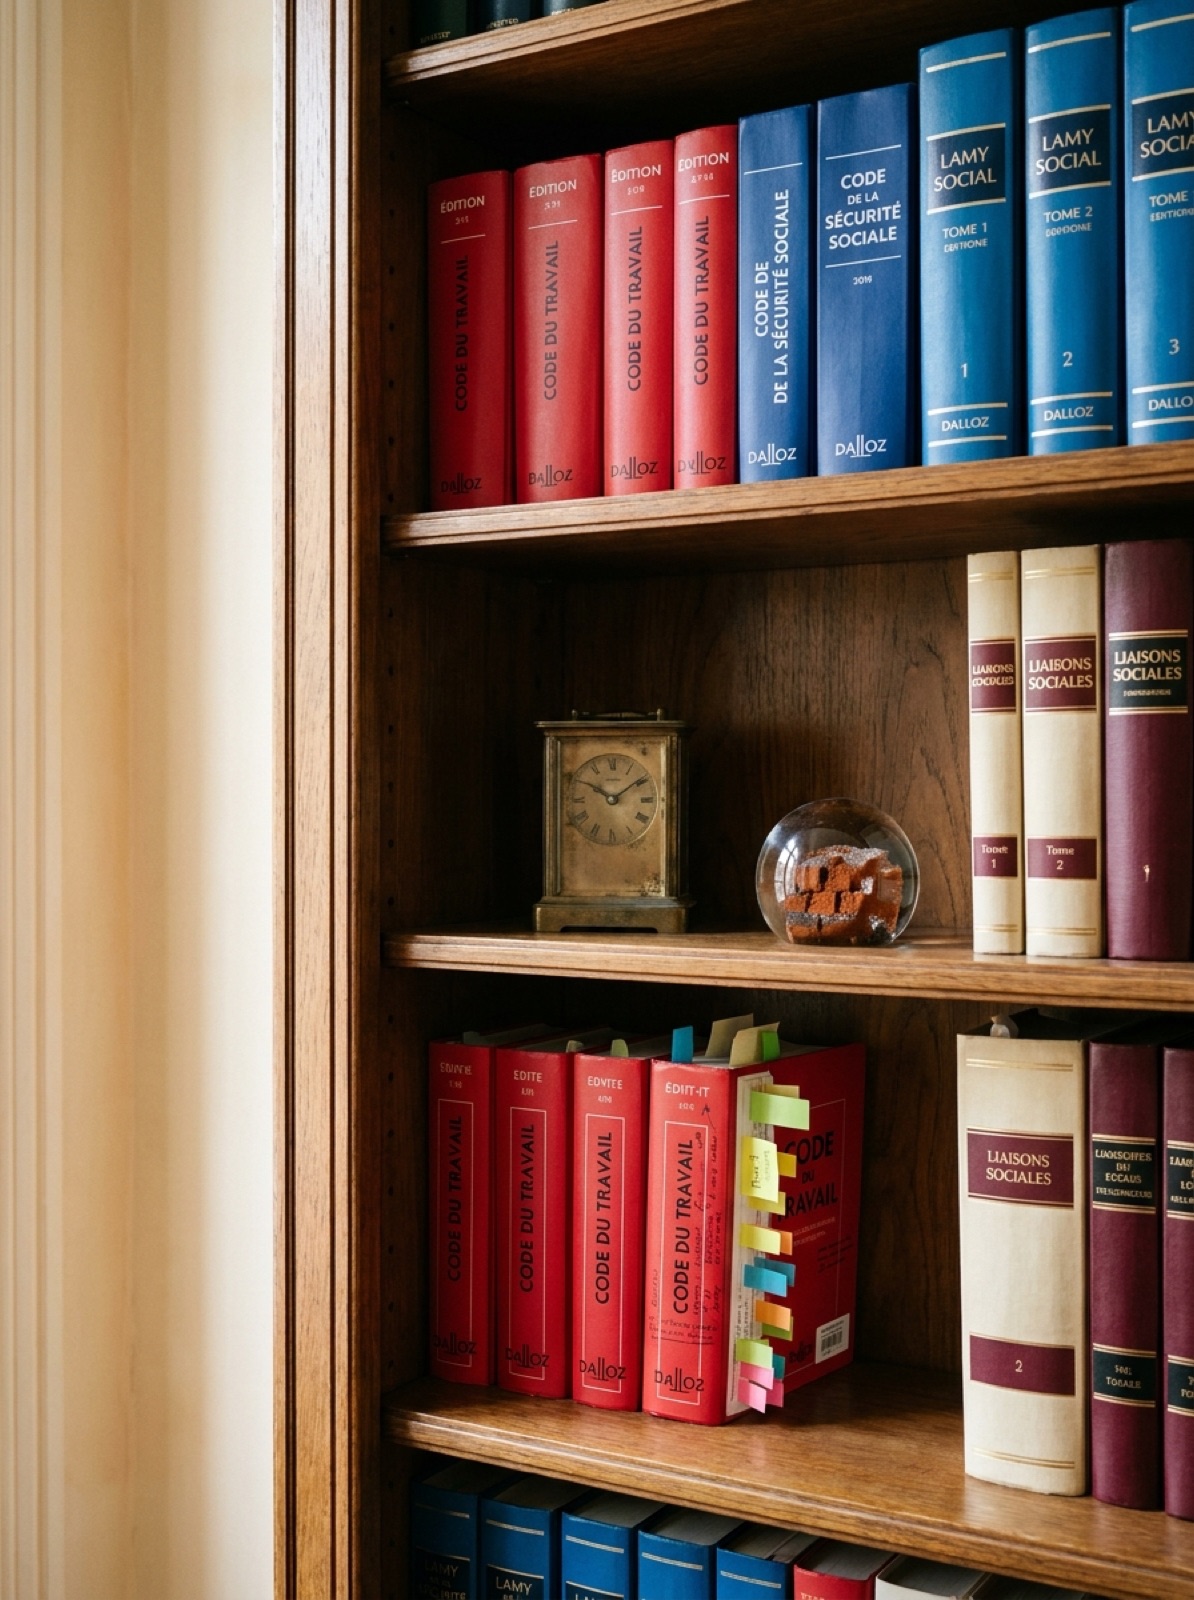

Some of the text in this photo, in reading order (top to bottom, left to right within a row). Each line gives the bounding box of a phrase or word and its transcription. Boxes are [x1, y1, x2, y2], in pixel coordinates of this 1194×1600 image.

[1043, 128, 1094, 152] LAMY
[941, 146, 989, 169] LAMY
[1035, 150, 1102, 176] SOCIAL
[840, 168, 886, 189] CODE
[933, 168, 997, 192] SOCIAL
[847, 191, 879, 205] DE LA
[1149, 190, 1189, 208] TOME
[825, 200, 901, 230] SÉCURITÉ
[1043, 206, 1094, 224] TOME 2
[828, 226, 898, 250] SOCIALE
[942, 222, 987, 239] TOME 1
[694, 215, 709, 386] CODE DU TRAVAIL
[755, 261, 769, 337] CODE DE
[772, 189, 789, 404] DE LA SÉCURITÉ SOCIALE
[627, 226, 642, 392] CODE DU TRAVAIL
[544, 240, 559, 401] CODE DU TRAVAIL
[455, 255, 469, 411] CODE DU TRAVAIL
[1169, 339, 1180, 355] 3
[1063, 351, 1073, 367] 2
[961, 363, 968, 378] 1
[1043, 406, 1094, 421] DALLOZ
[941, 416, 990, 432] DALLOZ
[1114, 649, 1181, 665] LIAISONS
[1028, 675, 1094, 690] SOCIALES
[1112, 666, 1182, 682] SOCIALES
[1046, 845, 1075, 856] Tome
[991, 859, 997, 869] 1
[1056, 860, 1064, 870] 2
[987, 1150, 1050, 1168] LIAISONS
[801, 1170, 815, 1184] DU
[986, 1168, 1052, 1186] SOCIALES
[448, 1116, 462, 1282] CODE DU TRAVAIL
[777, 1182, 838, 1222] RAVAIL
[520, 1124, 535, 1293] CODE DU TRAVAIL
[595, 1132, 612, 1305] CODE DU TRAVAIL
[673, 1139, 693, 1314] CODE DU TRAVAIL
[1015, 1359, 1023, 1373] 2
[424, 1560, 459, 1577] LAMY
[495, 1576, 533, 1596] LAMY
